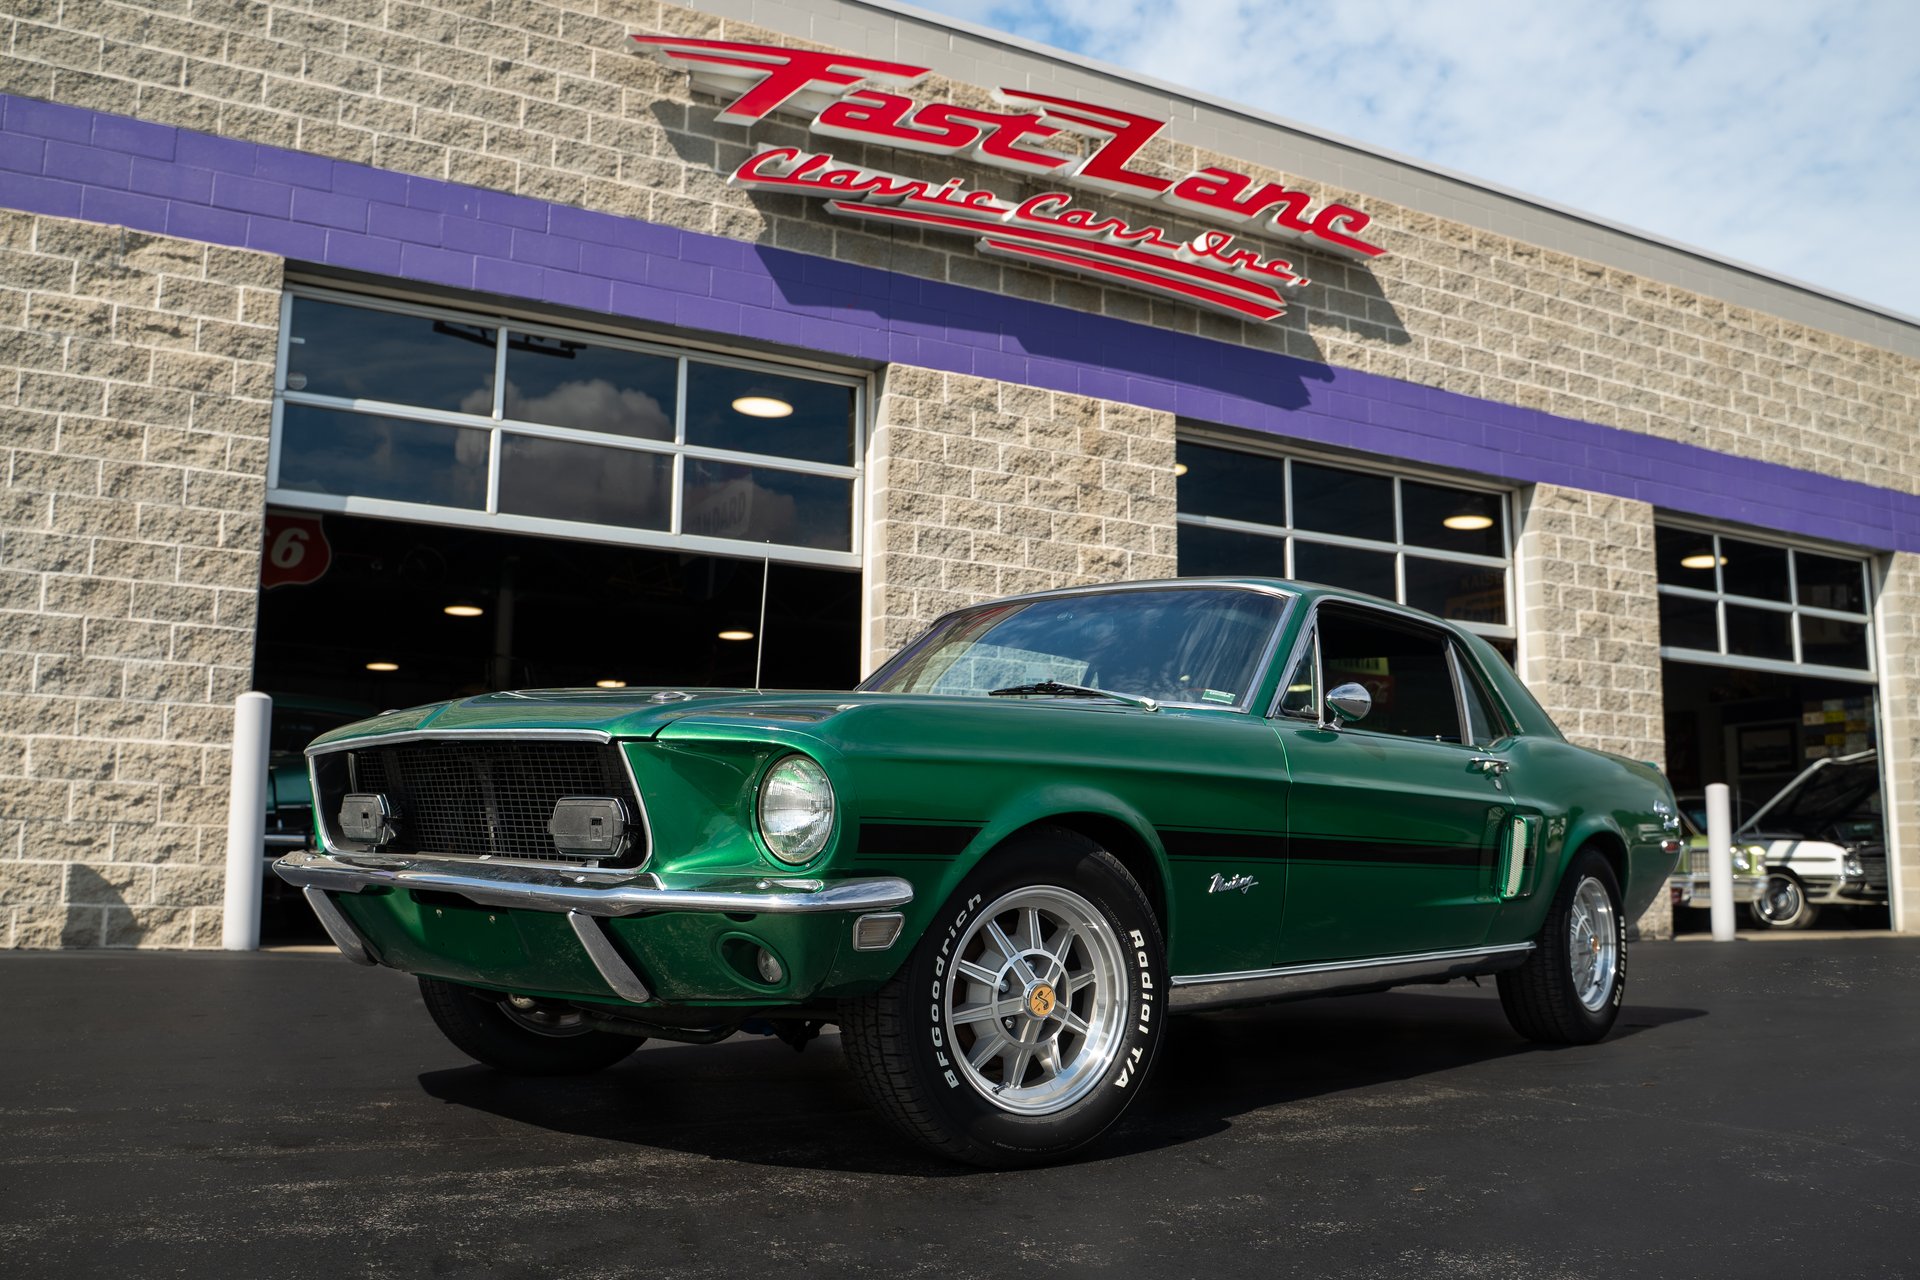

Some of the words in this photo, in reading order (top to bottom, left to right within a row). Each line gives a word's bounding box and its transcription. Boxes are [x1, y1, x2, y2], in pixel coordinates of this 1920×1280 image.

[628, 33, 1077, 173] Fast
[1000, 87, 1388, 258] Lane
[737, 147, 1014, 214] Classic
[1003, 191, 1186, 251] Cars
[1191, 229, 1312, 287] Inc.
[265, 526, 310, 569] 6
[1208, 872, 1259, 894] Mustang
[931, 893, 983, 1089] BFGoodrich
[1129, 928, 1153, 1035] Radial
[1114, 1047, 1144, 1089] T/A
